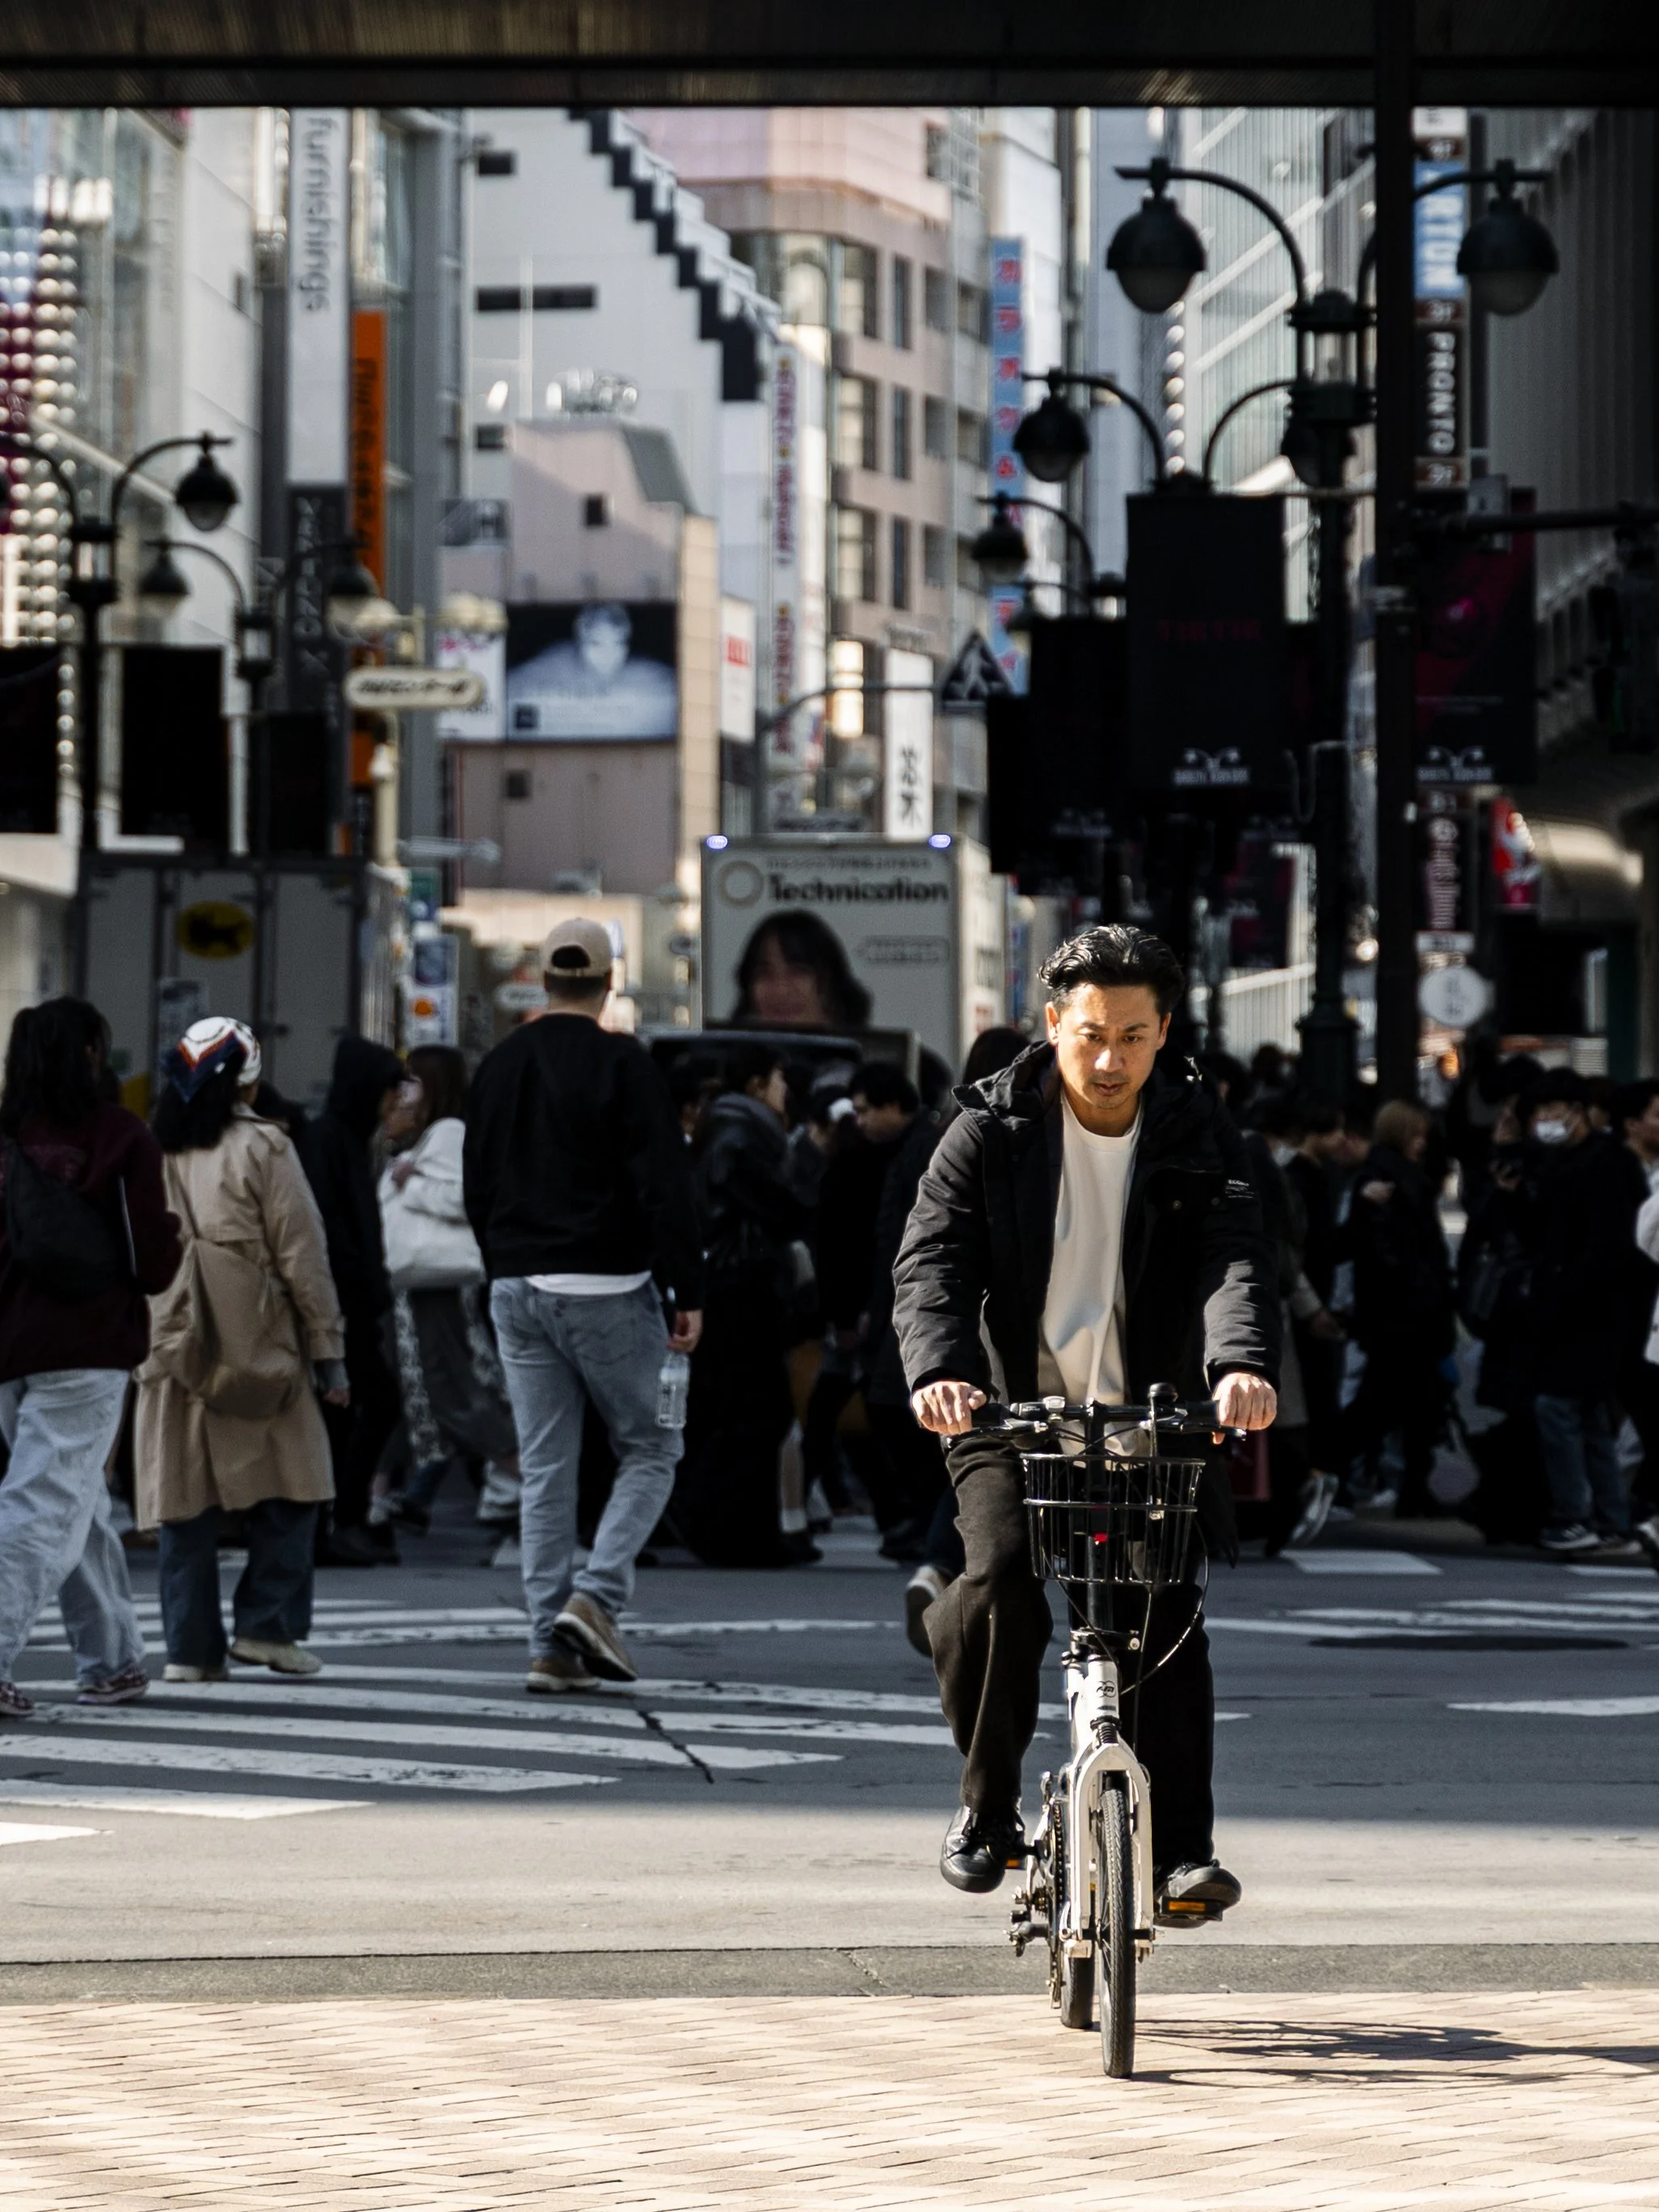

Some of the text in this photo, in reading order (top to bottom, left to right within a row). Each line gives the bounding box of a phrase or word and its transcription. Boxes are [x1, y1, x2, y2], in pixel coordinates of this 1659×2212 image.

[296, 116, 338, 313] furnishings
[1428, 331, 1456, 456] PRONTO
[769, 873, 948, 901] Technication
